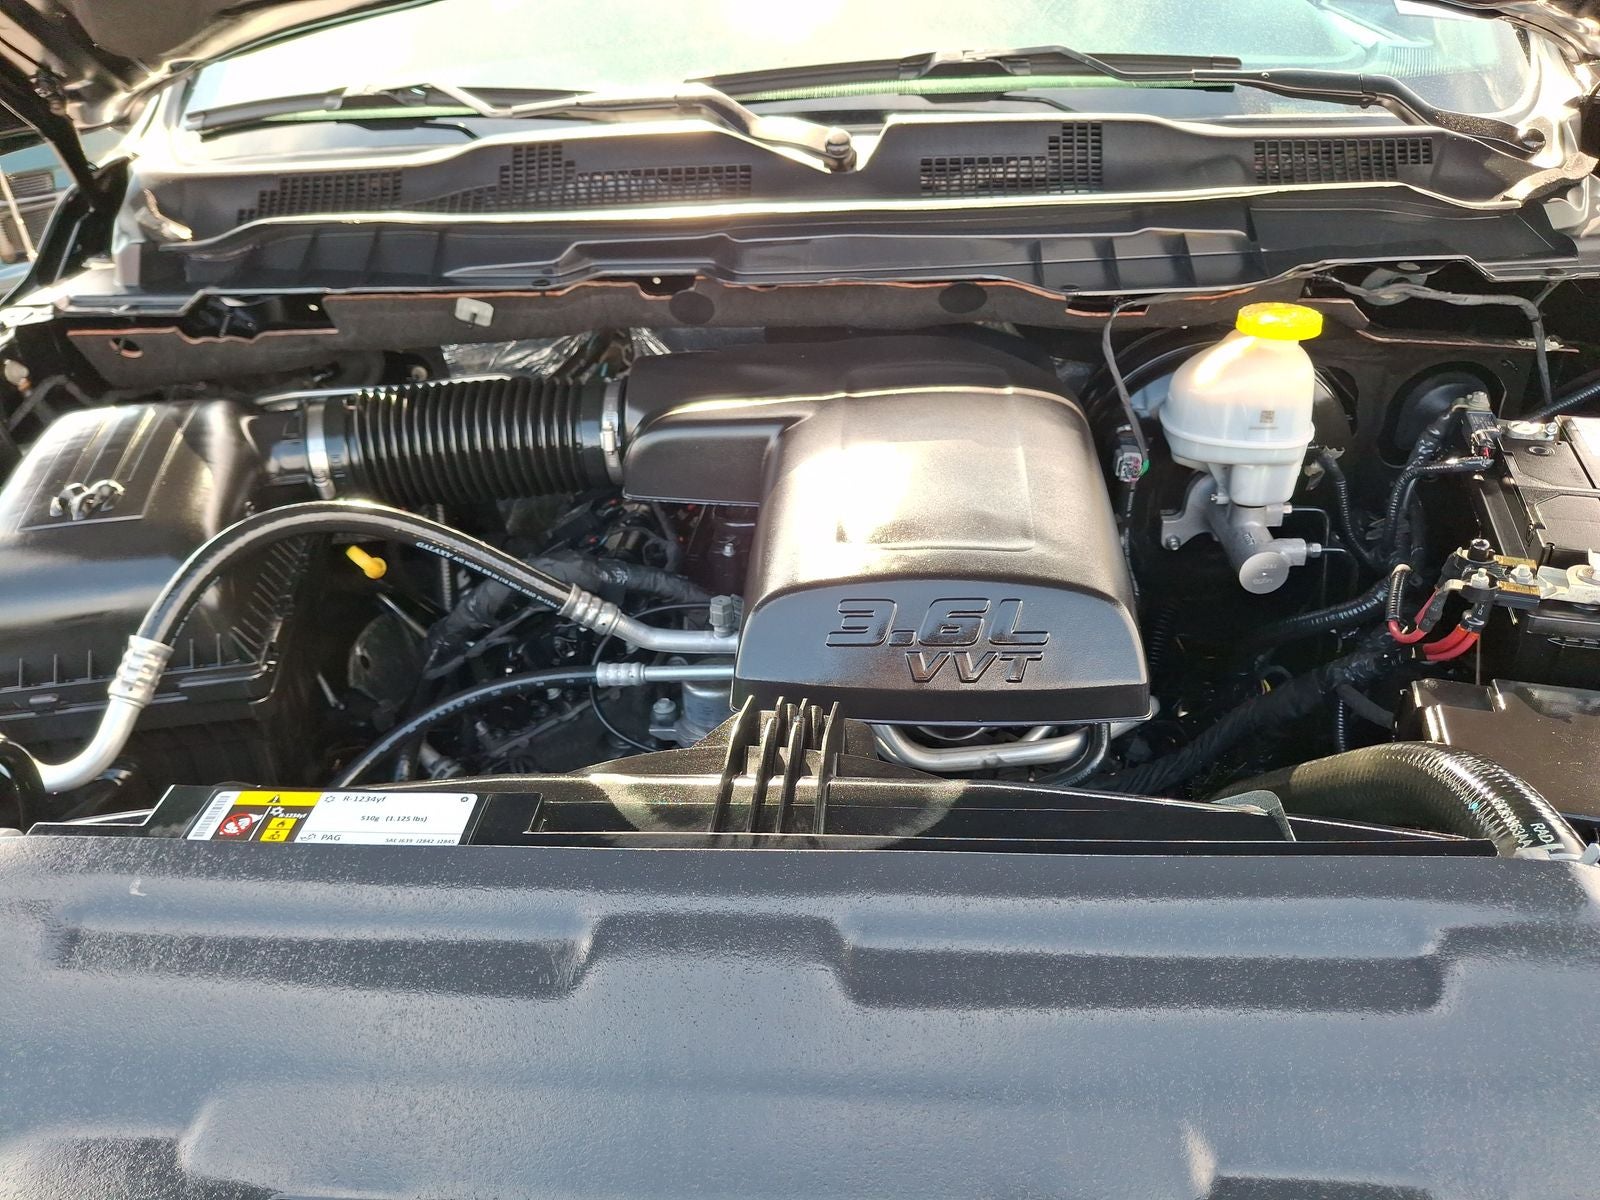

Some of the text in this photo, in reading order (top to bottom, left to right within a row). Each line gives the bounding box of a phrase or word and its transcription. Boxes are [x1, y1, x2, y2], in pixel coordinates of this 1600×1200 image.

[415, 541, 453, 558] GALAXY
[825, 596, 1050, 647] 3.6L
[904, 650, 1044, 683] VVT
[342, 795, 387, 804] R-1234yf
[360, 815, 428, 823] 510g (1.125 lbs)
[320, 833, 341, 842] PAG
[1530, 822, 1555, 845] RAD
